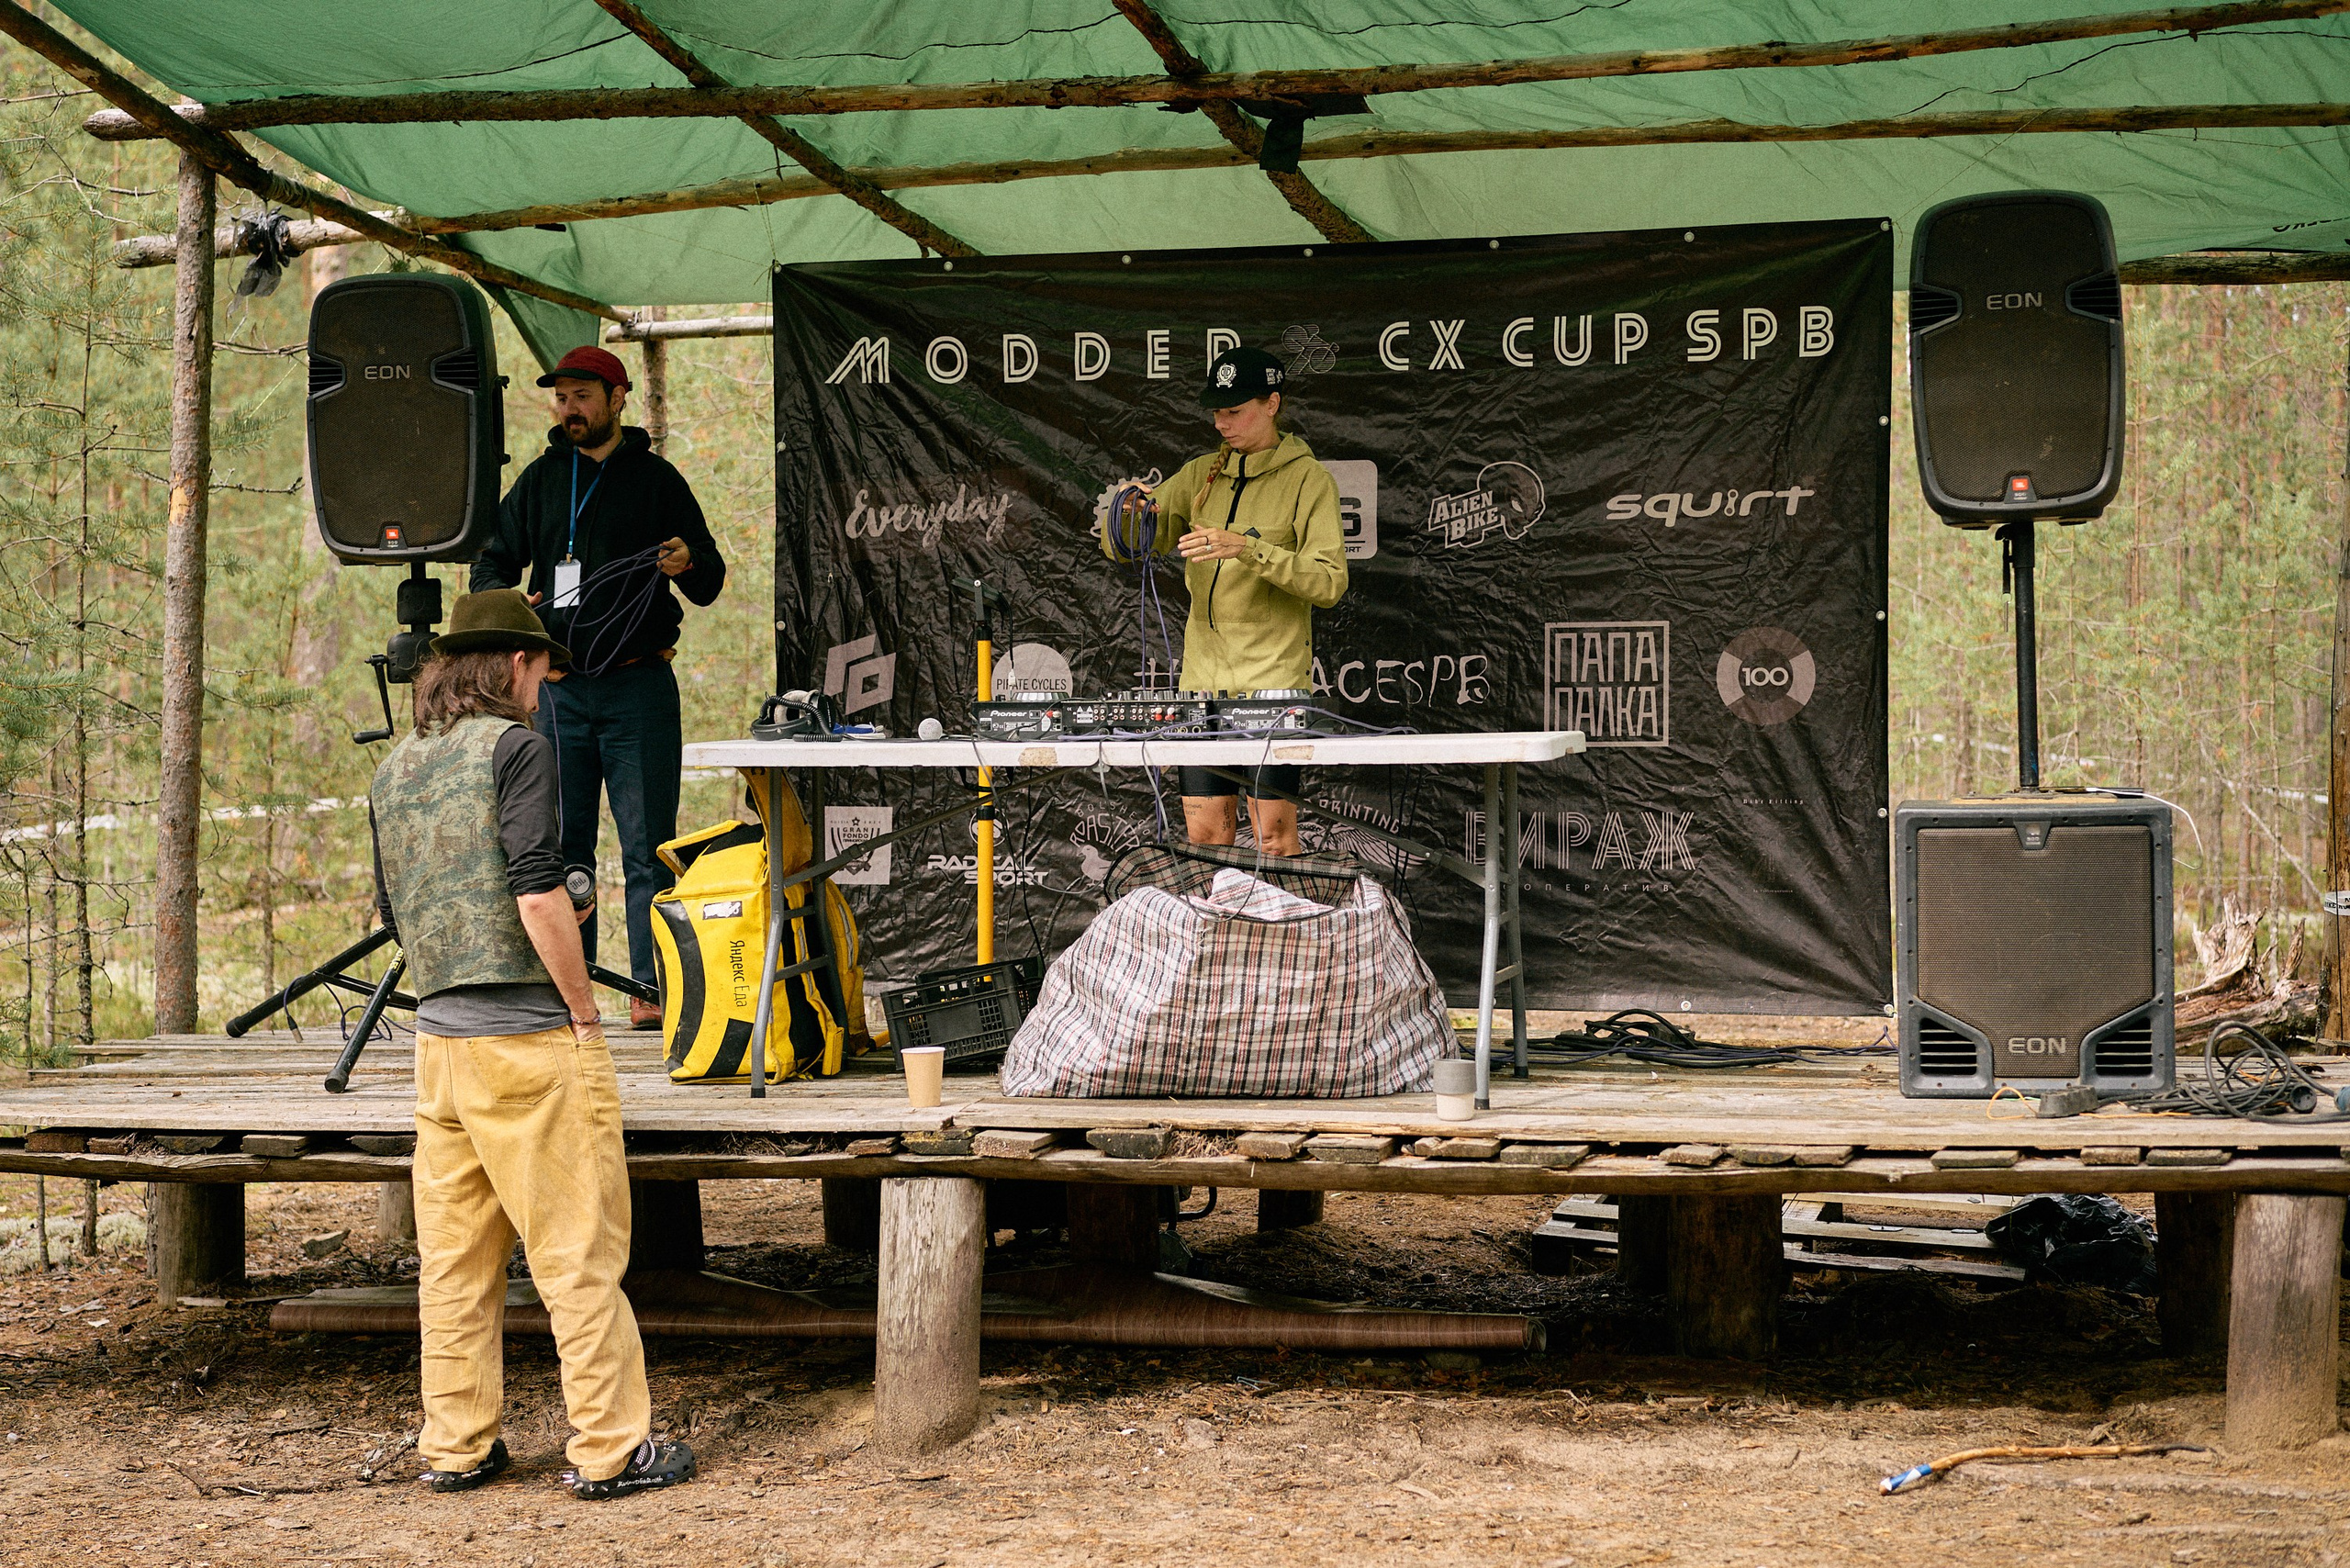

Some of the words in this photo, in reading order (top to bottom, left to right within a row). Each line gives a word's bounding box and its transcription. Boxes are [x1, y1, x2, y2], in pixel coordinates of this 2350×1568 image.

[1986, 291, 2042, 311] EON
[1378, 319, 1466, 371] CX
[1502, 312, 1649, 367] CUP
[1685, 306, 1835, 363] SPB
[364, 364, 411, 380] EON
[845, 483, 1013, 550] Everyday
[1606, 486, 1815, 528] squirt
[1450, 506, 1499, 542] BIKE
[1554, 632, 1660, 683] ПАПА
[1032, 678, 1068, 690] CYCLES
[1742, 666, 1789, 687] 100
[1231, 707, 1270, 715] Pioneer
[1554, 686, 1659, 737] ПАЛКА
[927, 854, 1035, 872] RADAL
[569, 876, 587, 890] JBL
[964, 870, 1049, 888] SORT
[1503, 882, 1670, 893] ОПЕРАТИВ
[729, 939, 745, 983] Яндекс
[733, 985, 750, 1008] Еда
[2007, 1036, 2067, 1055] EON
